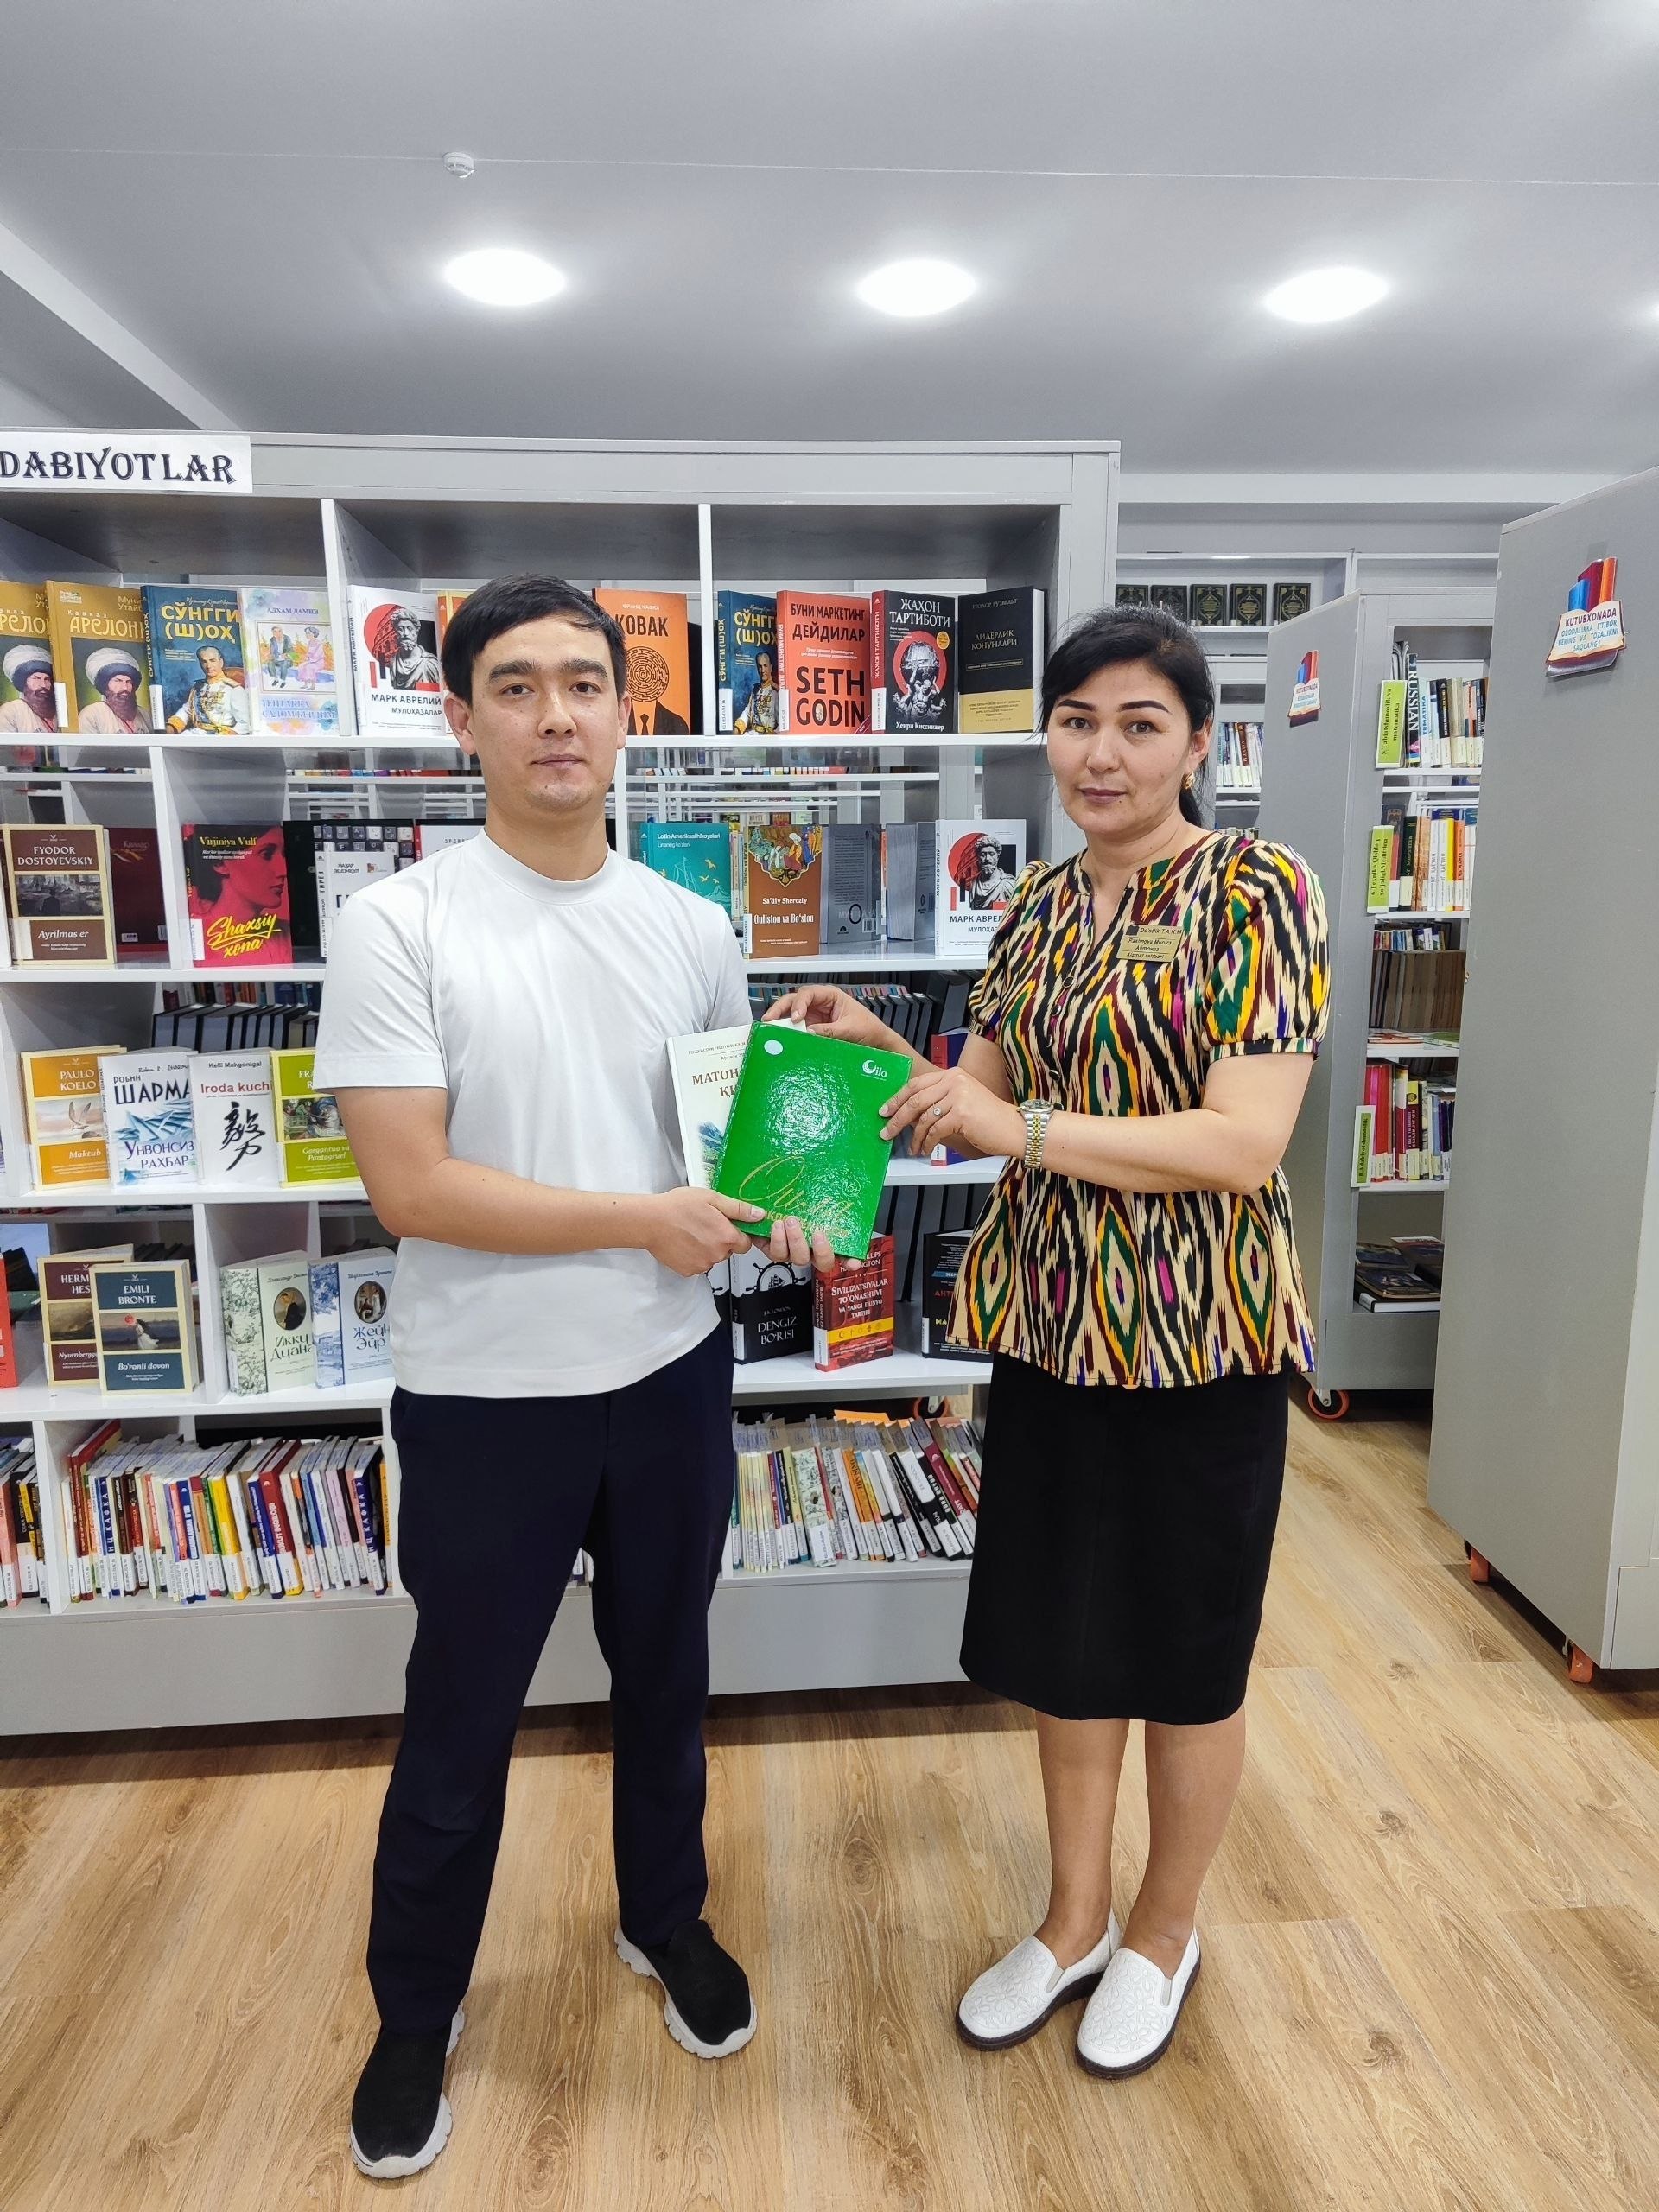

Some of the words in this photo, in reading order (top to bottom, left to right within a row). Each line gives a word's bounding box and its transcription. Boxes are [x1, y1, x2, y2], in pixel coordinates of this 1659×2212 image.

[0, 446, 236, 484] DABIYOTLAR
[162, 601, 242, 623] СЎНГГИ
[791, 603, 815, 617] БУНИ
[816, 605, 865, 621] МАРКЕТИНГ
[901, 598, 940, 613] ЖАҲОН
[734, 608, 777, 627] СЎНГГ
[889, 612, 950, 628] ТАРТИБОТИ
[1566, 607, 1617, 627] KUTUBXONADA
[792, 621, 866, 643] ДЕЙДИЛАР
[975, 629, 1014, 641] ЛИДЕРЛИК
[796, 666, 865, 696] SETH
[372, 694, 397, 702] МАРК
[400, 695, 442, 705] АВРЕЛИЙ
[1408, 671, 1419, 731] RUSSIAN
[796, 697, 865, 728] GODIN
[199, 836, 236, 848] Virjiniya
[238, 836, 257, 846] Vulf
[33, 846, 76, 855] FYODOR
[17, 856, 93, 866] DOSTOYEVSKIY
[754, 914, 780, 925] Guliston
[38, 930, 79, 940] Ayrilmas
[207, 913, 281, 947] Shaxsiy
[223, 938, 264, 959] xona
[60, 1069, 95, 1080] PAULO
[692, 1068, 740, 1085] МАТОН
[60, 1081, 96, 1091] KOELO
[113, 1078, 190, 1104] ШАРМА
[200, 1083, 234, 1094] Iroda
[69, 1149, 101, 1160] Maktub
[60, 1274, 90, 1283] HERM
[72, 1285, 91, 1294] HES
[124, 1285, 149, 1294] EMILI
[831, 1278, 888, 1296] SIVILIZATSIYALAR
[118, 1295, 156, 1306] BRONTE
[758, 1315, 798, 1333] DENGIZ
[102, 1493, 111, 1531] КАФКА
[359, 1494, 370, 1532] КАФКА
